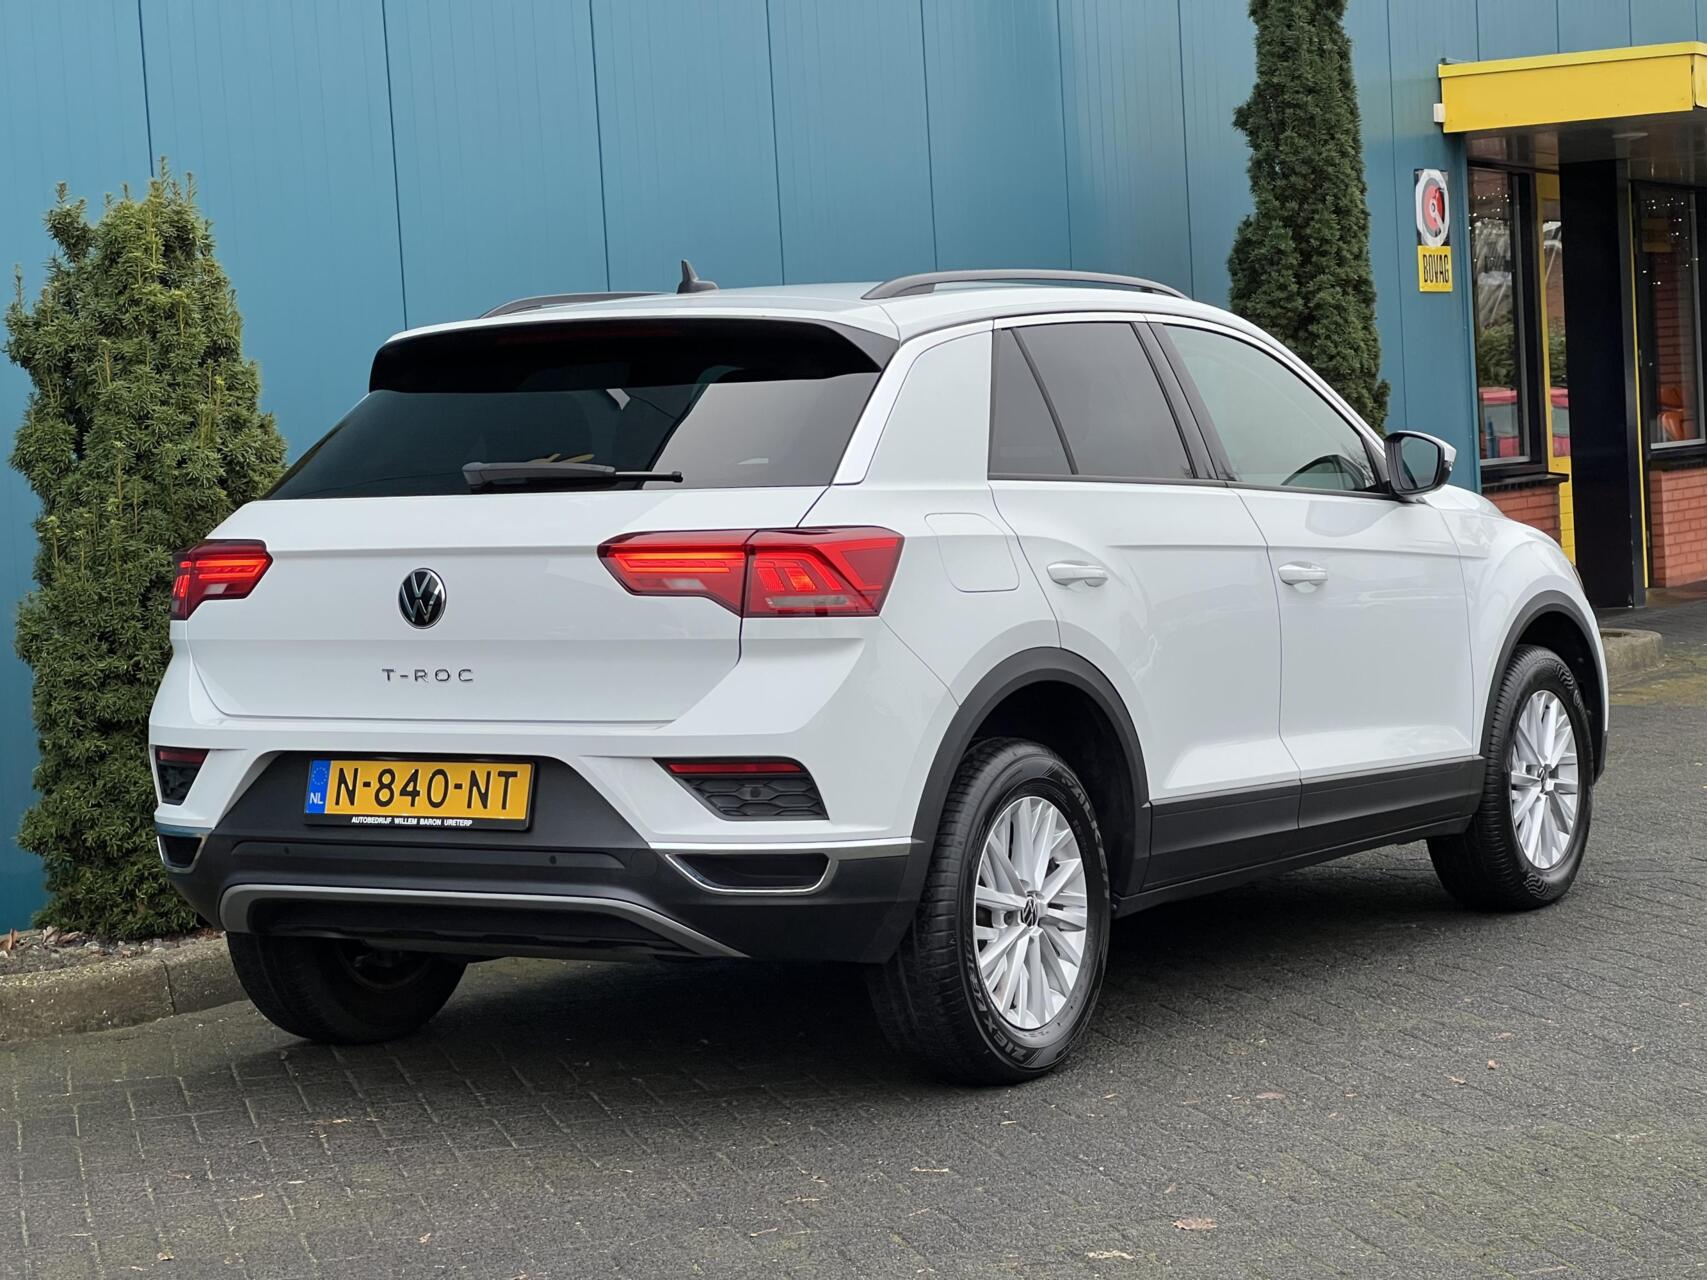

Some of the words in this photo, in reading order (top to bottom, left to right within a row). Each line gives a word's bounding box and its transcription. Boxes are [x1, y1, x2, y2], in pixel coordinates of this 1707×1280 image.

[1422, 254, 1449, 283] BOVAG
[382, 668, 474, 682] T-ROC
[334, 767, 518, 811] N-840-NT
[309, 792, 324, 805] NL
[351, 816, 392, 825] AUTOBEDRIJF
[394, 817, 418, 825] WILLEM
[420, 818, 441, 826] BARON
[443, 819, 473, 827] URETERP
